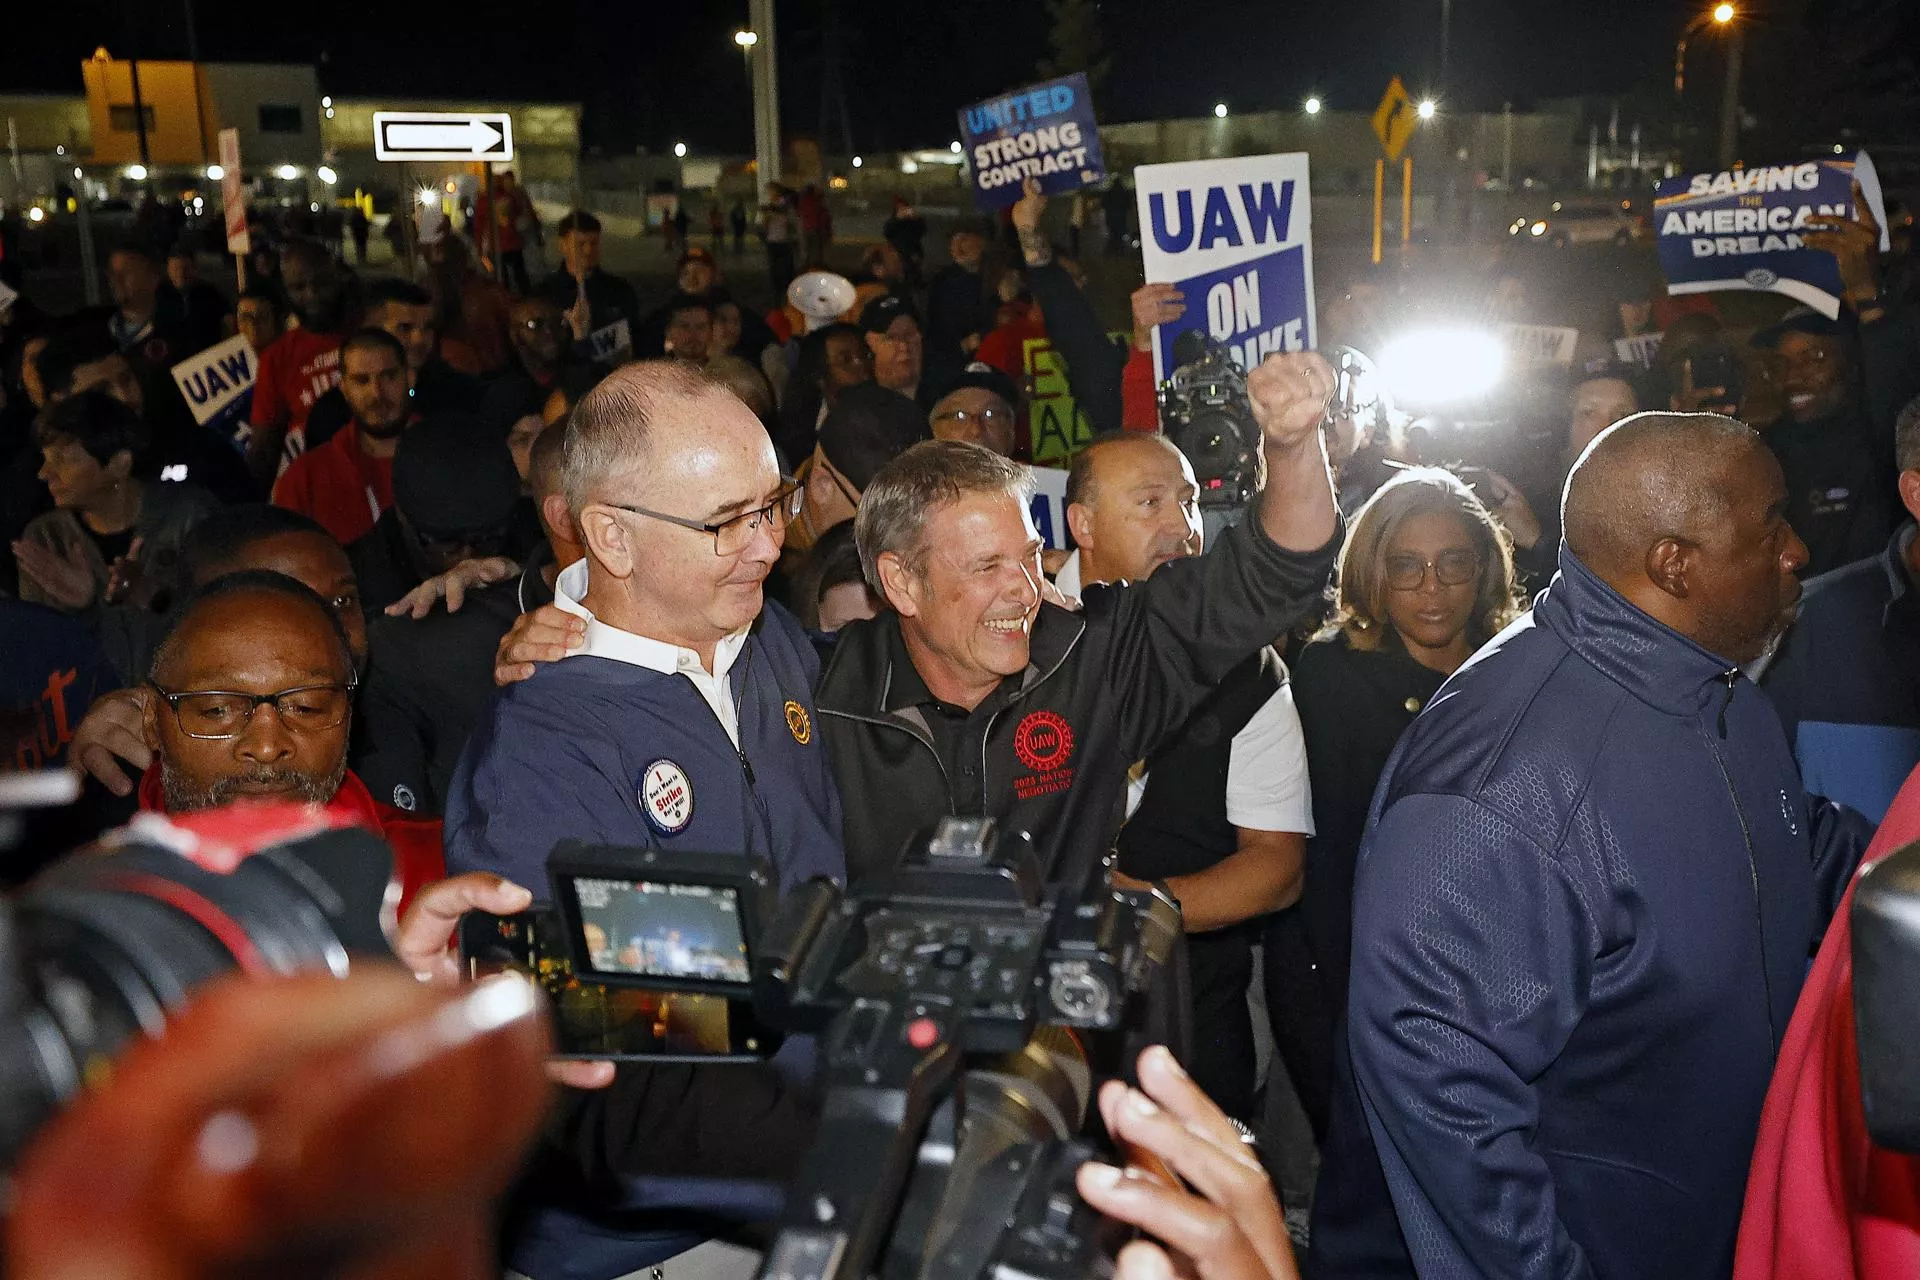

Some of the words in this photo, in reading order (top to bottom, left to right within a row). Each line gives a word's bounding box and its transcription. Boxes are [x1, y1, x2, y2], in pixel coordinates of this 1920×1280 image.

[966, 84, 1075, 135] UNITED
[973, 121, 1082, 170] STRONG
[977, 146, 1088, 190] CONTRACT
[1689, 162, 1820, 196] SAVING
[1148, 179, 1296, 254] UAW
[1738, 195, 1764, 207] THE
[1206, 269, 1262, 342] ON
[183, 350, 251, 405] UAW
[1029, 732, 1056, 751] UAW
[655, 771, 663, 783] I
[1014, 775, 1036, 789] 2023
[655, 786, 683, 812] Strike
